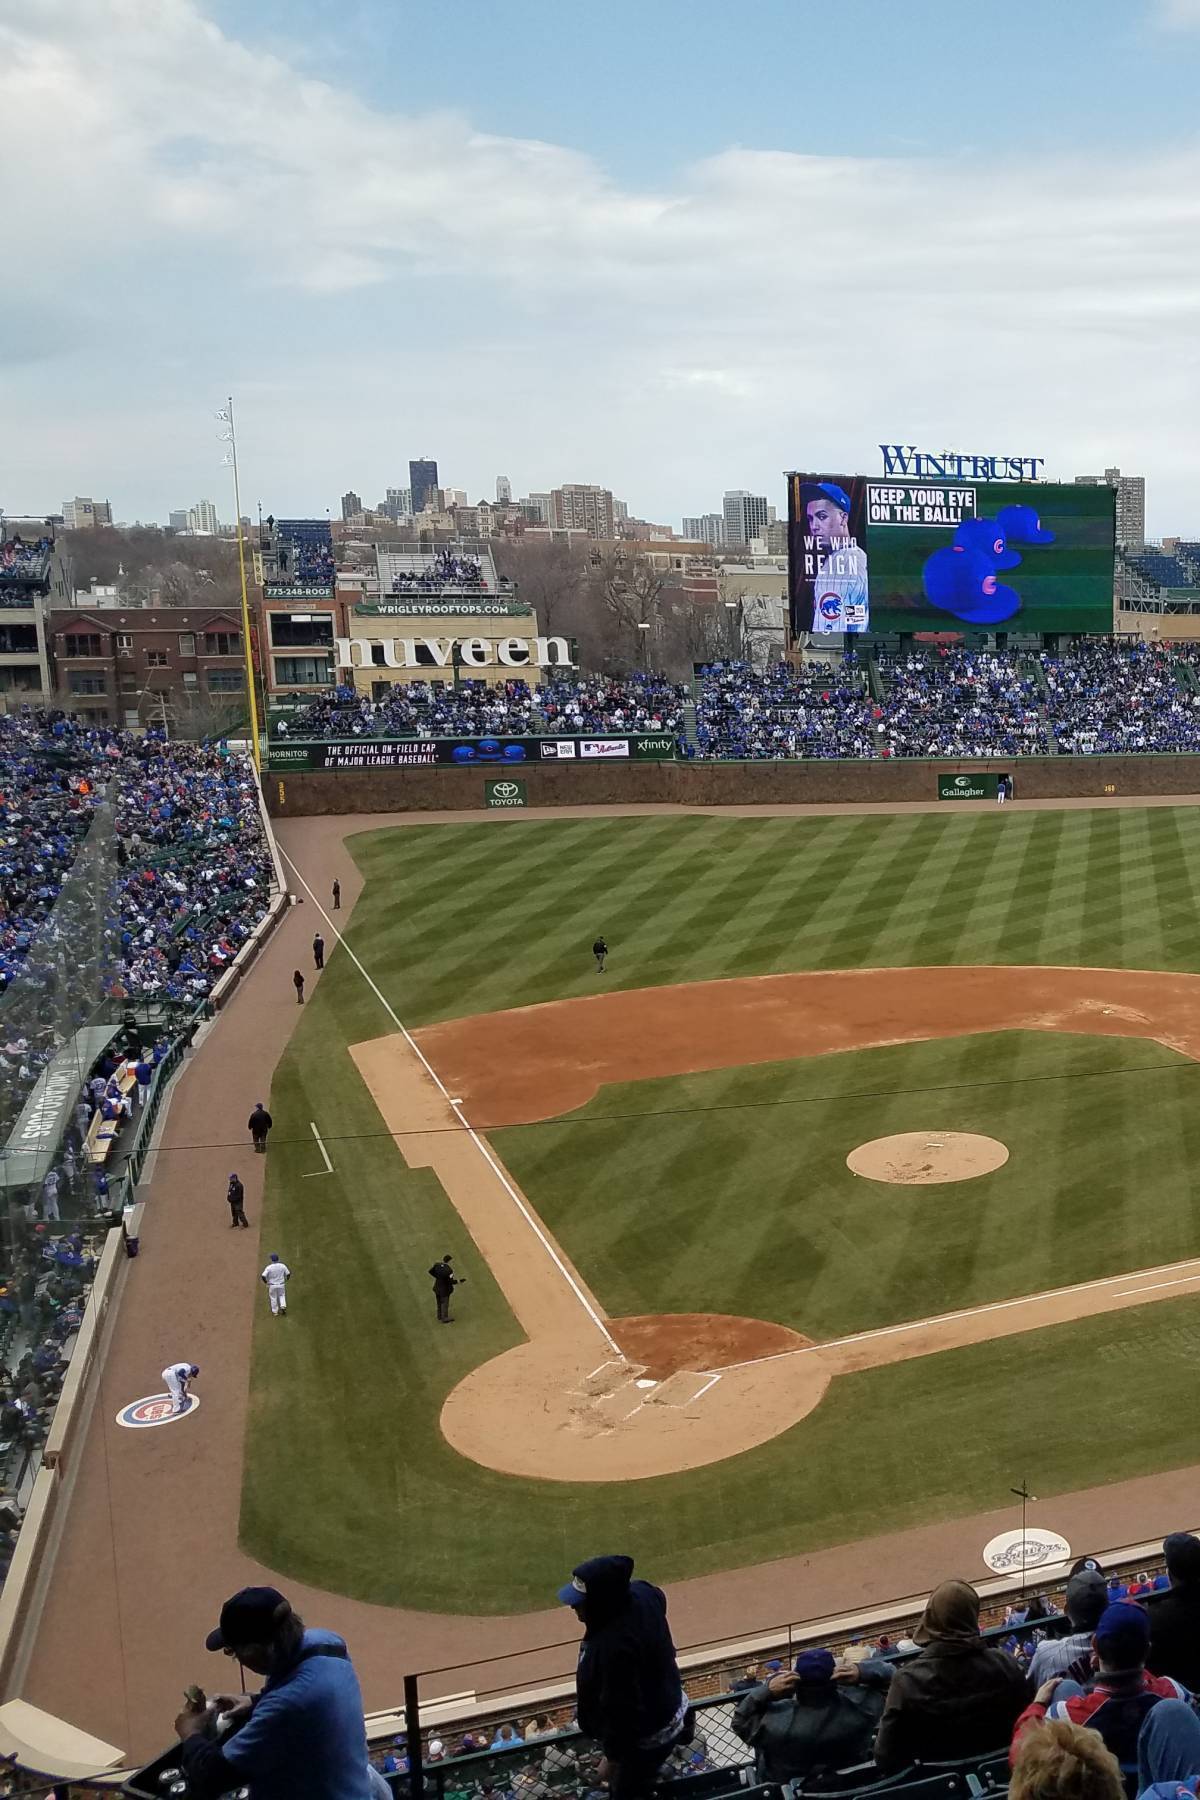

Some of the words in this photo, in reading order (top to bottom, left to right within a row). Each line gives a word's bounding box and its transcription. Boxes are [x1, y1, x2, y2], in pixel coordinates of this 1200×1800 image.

[878, 444, 1044, 481] WINTRUST
[870, 488, 905, 504] KEEP
[909, 490, 946, 506] YOUR
[948, 491, 973, 507] EYE
[84, 504, 92, 513] B
[871, 505, 890, 520] ON
[894, 506, 920, 521] THE
[924, 507, 963, 523] BALL!
[803, 535, 823, 551] WE
[830, 536, 858, 551] WHO
[804, 554, 858, 575] REIGN
[377, 604, 509, 614] WRIGLEYROOFTOPS.COM
[334, 636, 574, 668] nuveen
[328, 746, 341, 755] THE
[345, 745, 379, 755] OFFICIAL
[382, 744, 418, 754] ON-FIELD
[421, 743, 436, 752] CAP
[637, 739, 673, 751] xfinity
[269, 750, 308, 758] HORNITOS
[324, 757, 334, 767] OF
[337, 756, 364, 766] MAJOR
[367, 755, 396, 765] LEAGUE
[942, 788, 985, 797] Gallagher
[490, 798, 523, 806] TOYOTA
[35, 1069, 79, 1110] CHICAGO
[20, 1110, 60, 1139] CUBS
